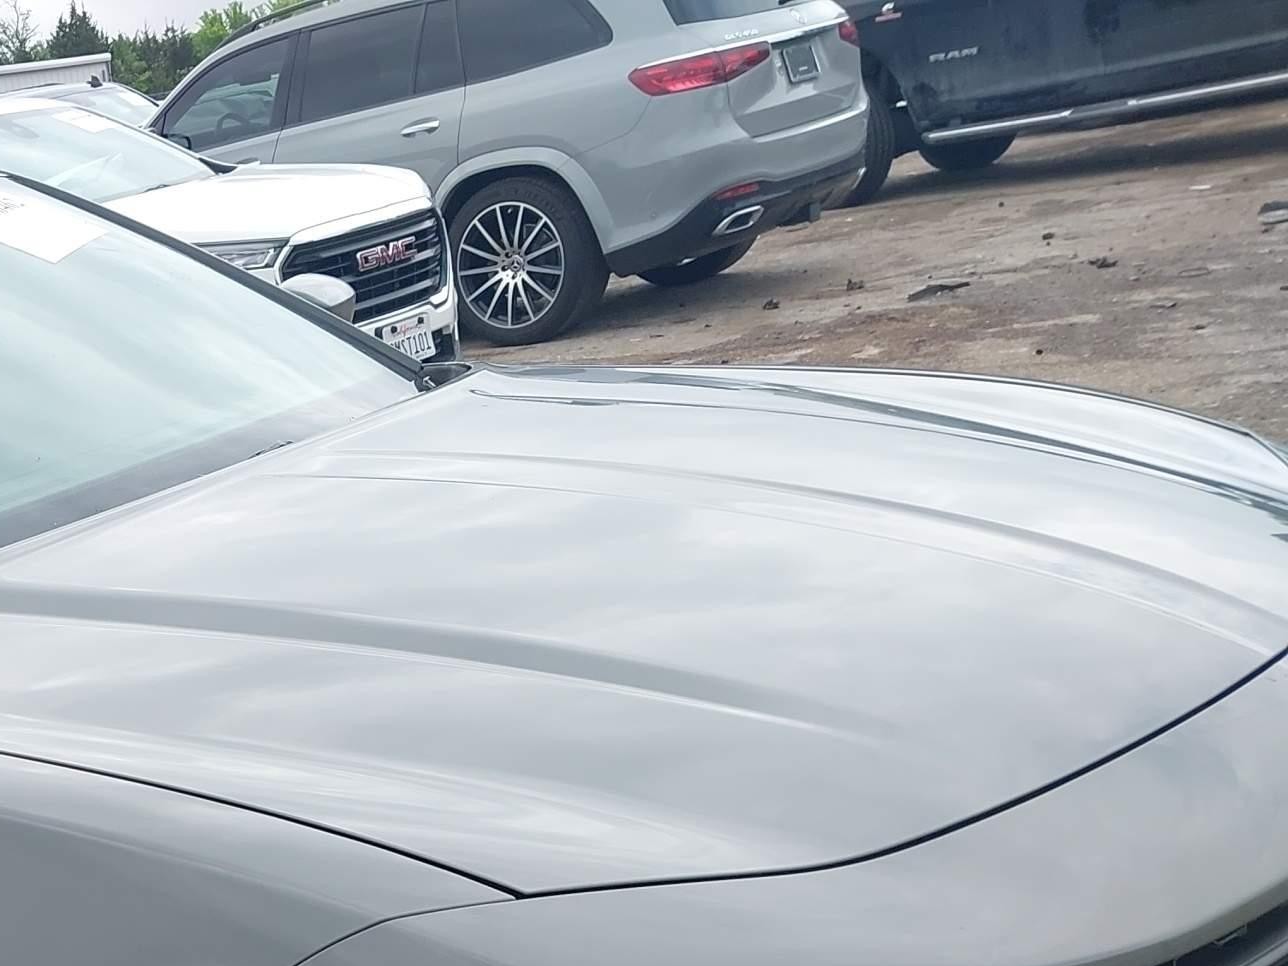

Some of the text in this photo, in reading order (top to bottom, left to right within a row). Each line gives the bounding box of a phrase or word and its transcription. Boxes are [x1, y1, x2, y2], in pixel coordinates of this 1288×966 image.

[929, 46, 979, 62] RAM
[356, 236, 417, 272] GMC
[390, 331, 432, 356] ST101
